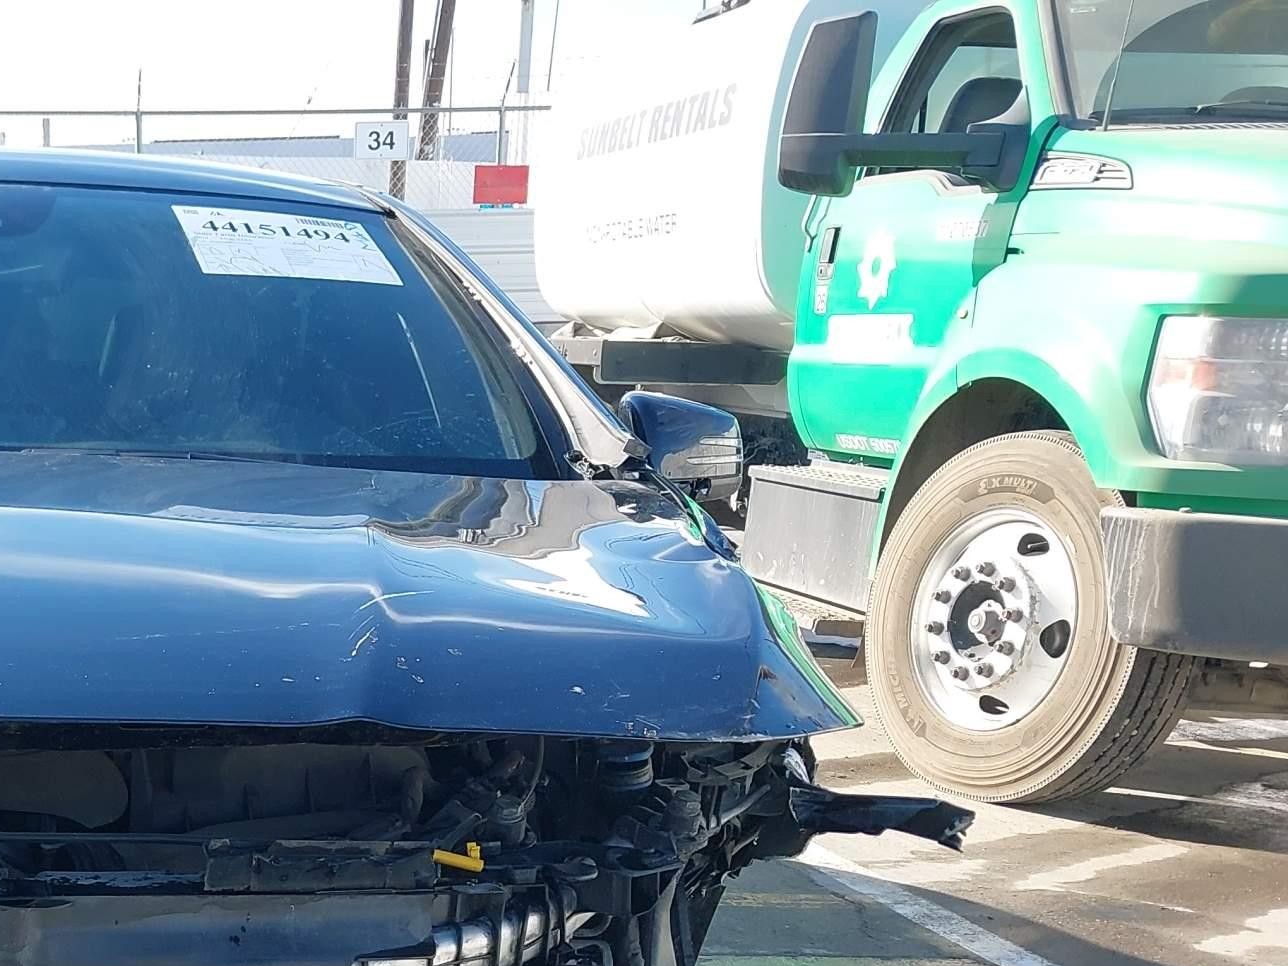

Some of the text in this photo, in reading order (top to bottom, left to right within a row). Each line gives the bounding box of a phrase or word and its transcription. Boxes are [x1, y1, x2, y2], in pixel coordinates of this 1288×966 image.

[576, 82, 737, 160] SUNBELT RENTALS
[367, 130, 396, 151] 34
[202, 219, 350, 244] 44151494
[646, 212, 678, 237] WATER
